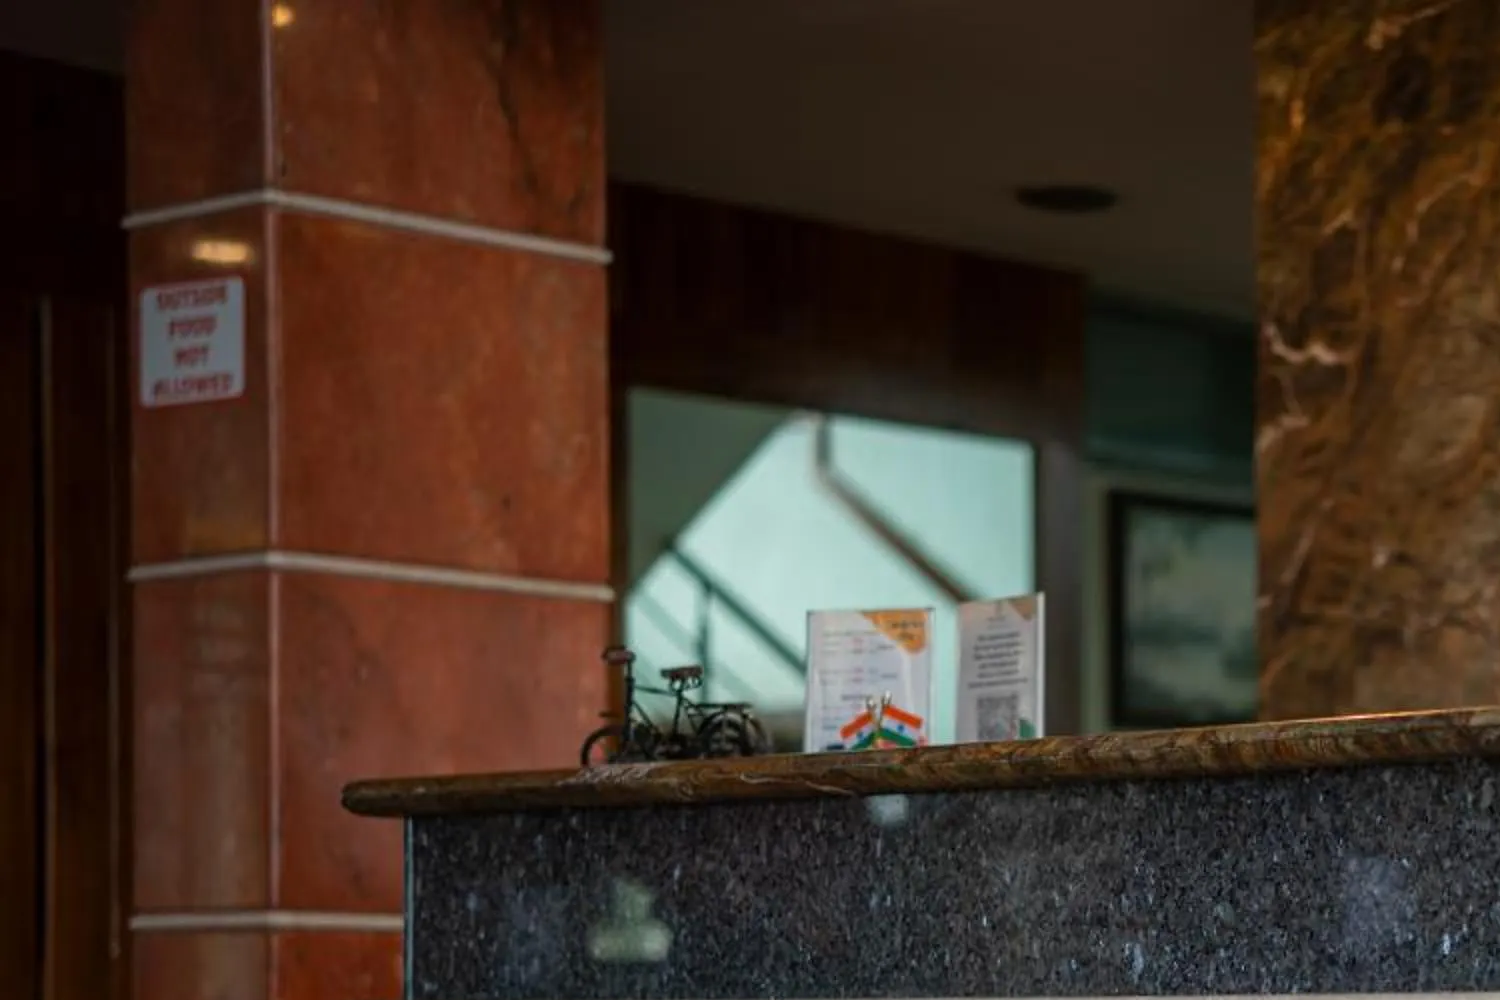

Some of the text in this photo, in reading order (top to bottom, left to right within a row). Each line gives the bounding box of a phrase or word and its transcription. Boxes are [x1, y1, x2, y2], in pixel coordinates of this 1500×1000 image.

[168, 317, 217, 338] FOOD
[174, 345, 209, 366] NOT
[153, 373, 233, 397] ALLOWED
